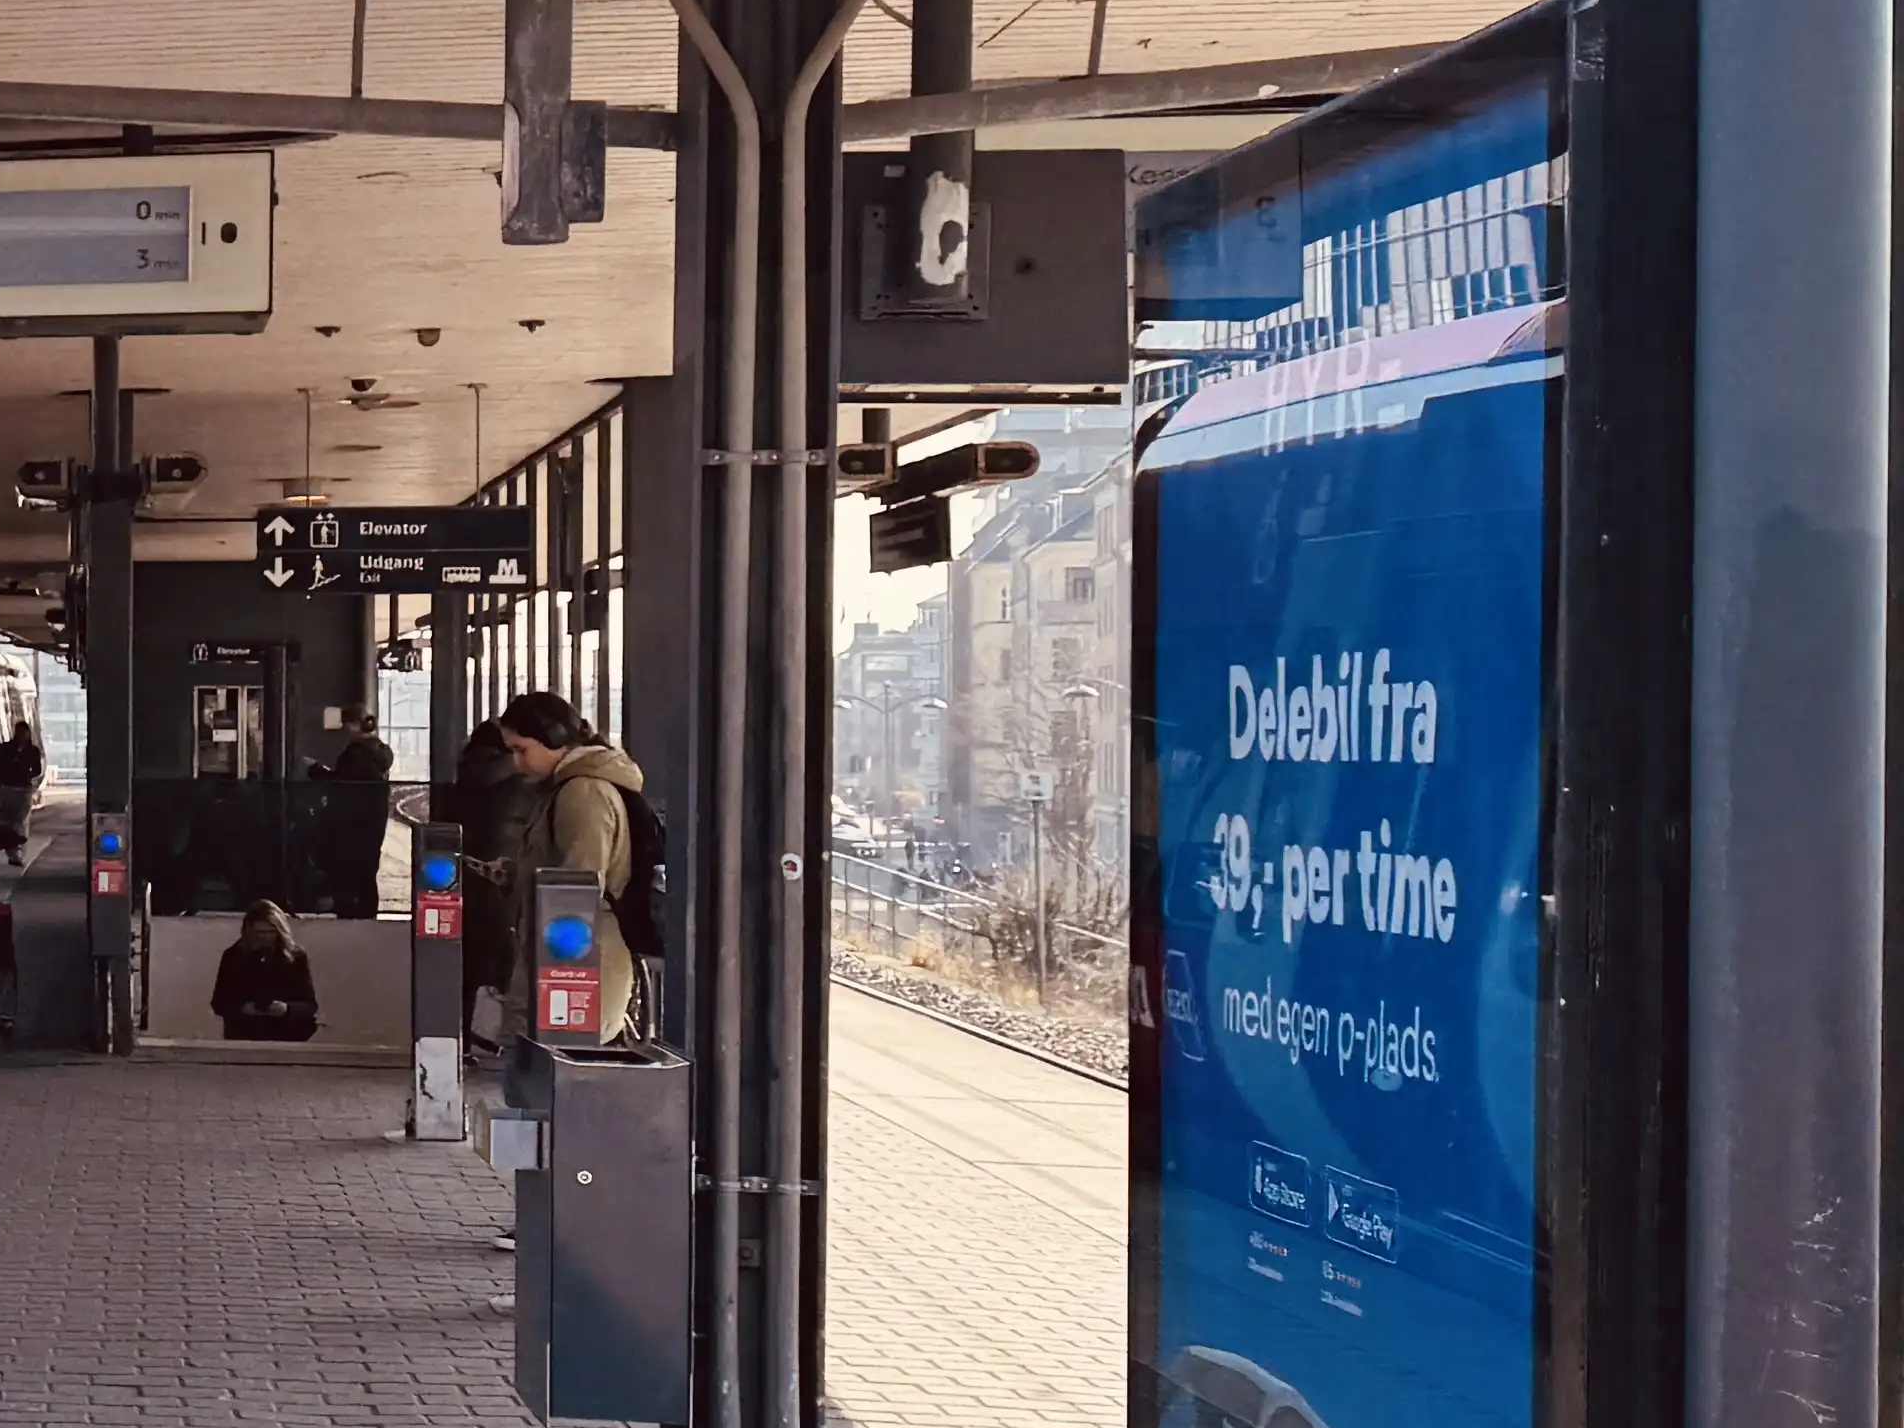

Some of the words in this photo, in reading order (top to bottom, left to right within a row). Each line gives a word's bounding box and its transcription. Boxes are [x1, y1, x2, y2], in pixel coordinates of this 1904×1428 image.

[135, 200, 152, 221] 0
[135, 248, 150, 270] 3
[359, 521, 428, 536] Elevator
[359, 555, 425, 571] Udgang
[1229, 651, 1363, 762] Delebil
[1368, 648, 1438, 764] fra
[1209, 812, 1274, 930] 39,-
[1282, 844, 1351, 944] per
[1357, 817, 1457, 943] time
[1223, 976, 1273, 1040] med
[1276, 1000, 1330, 1066] egen
